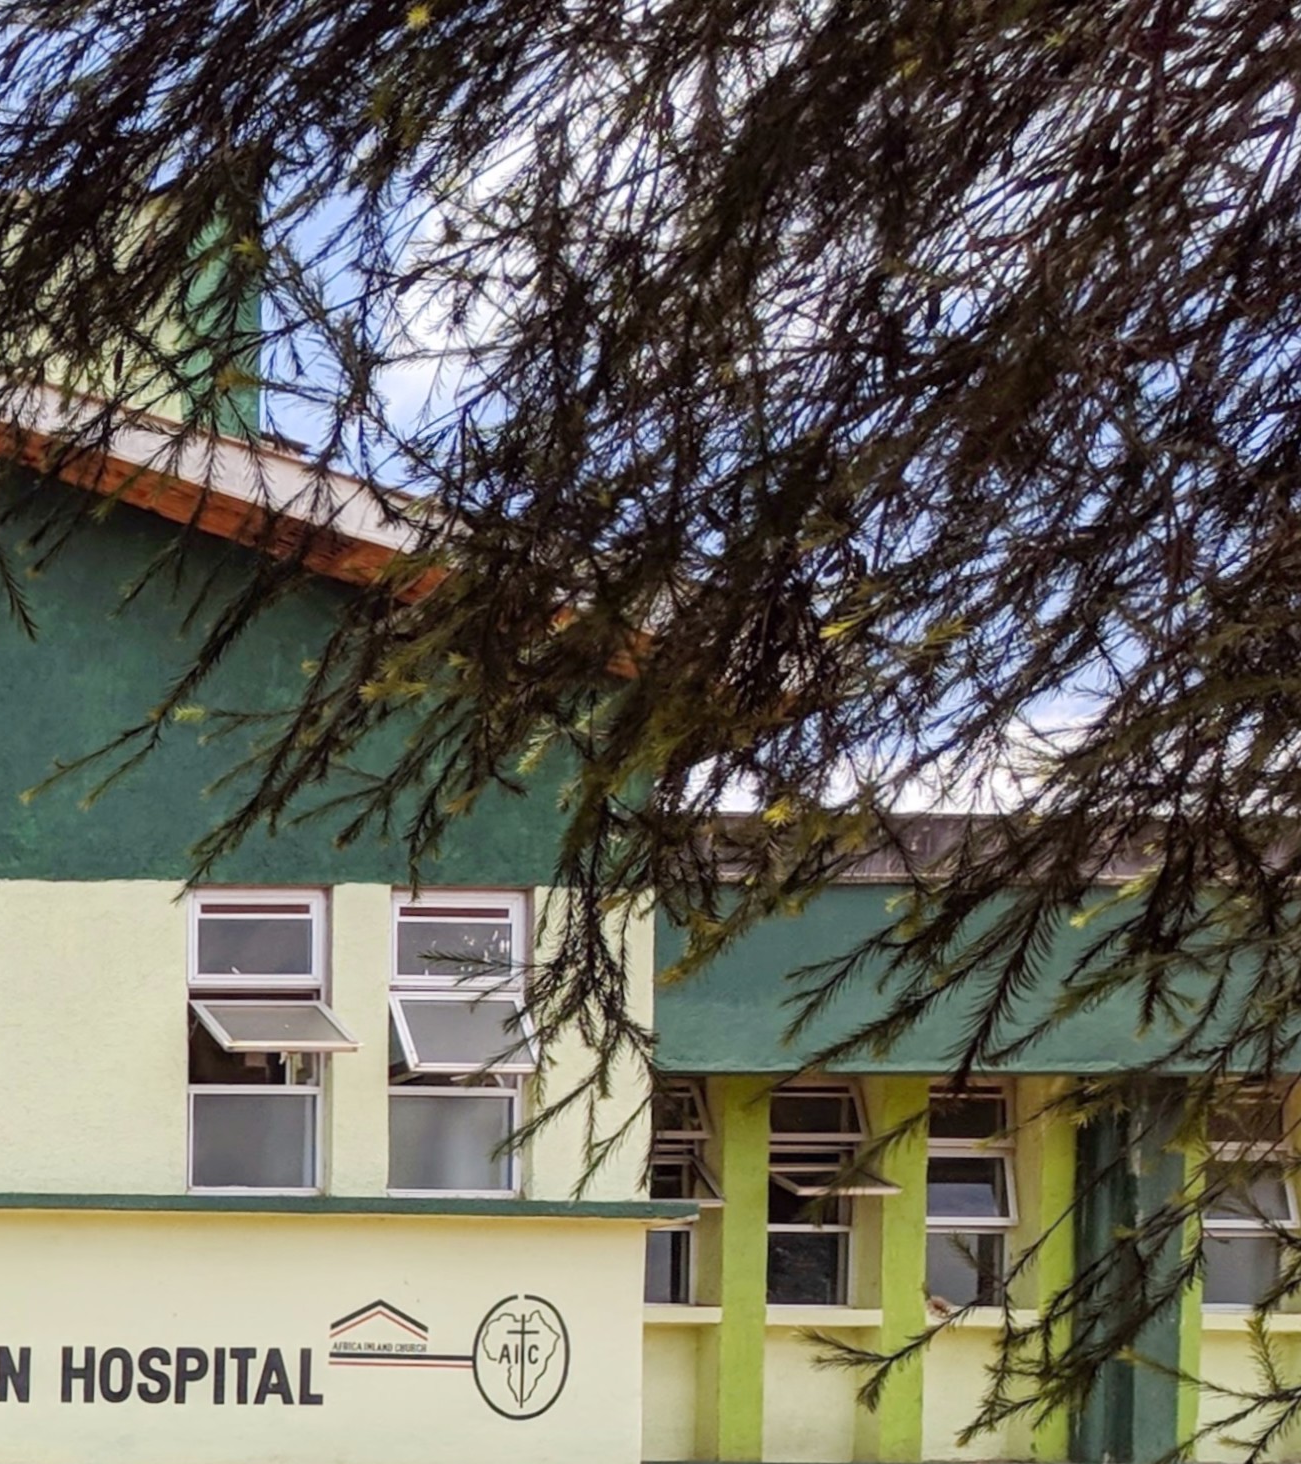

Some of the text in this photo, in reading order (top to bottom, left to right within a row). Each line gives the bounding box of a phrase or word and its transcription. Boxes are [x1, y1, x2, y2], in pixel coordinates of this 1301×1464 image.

[332, 1341, 427, 1353] AFRICA INLAND CHURCH
[498, 1343, 539, 1365] AIC
[60, 1346, 324, 1406] HOSPITAL
